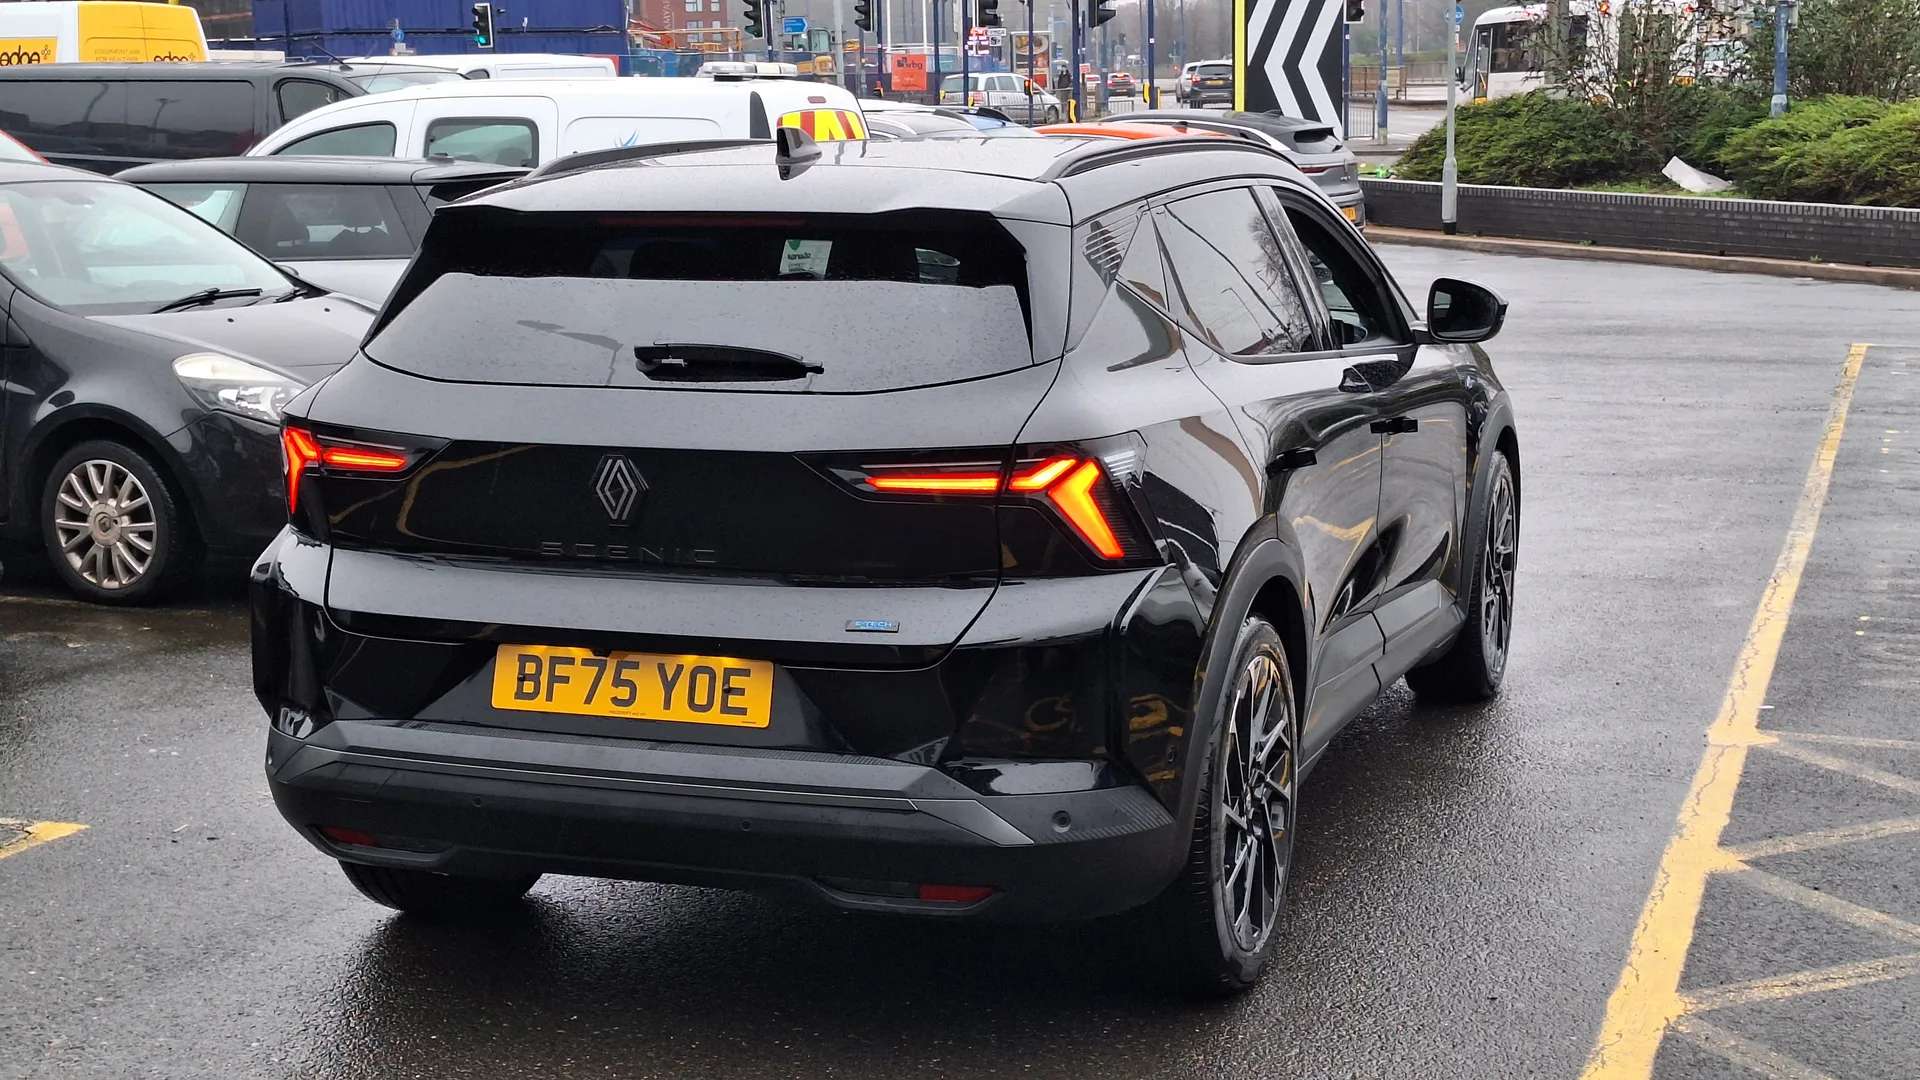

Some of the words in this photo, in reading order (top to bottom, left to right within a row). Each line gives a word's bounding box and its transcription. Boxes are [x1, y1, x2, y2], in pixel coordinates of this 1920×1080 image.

[540, 541, 718, 563] SCENIC
[514, 653, 640, 707] BF75
[657, 662, 752, 716] YOE
